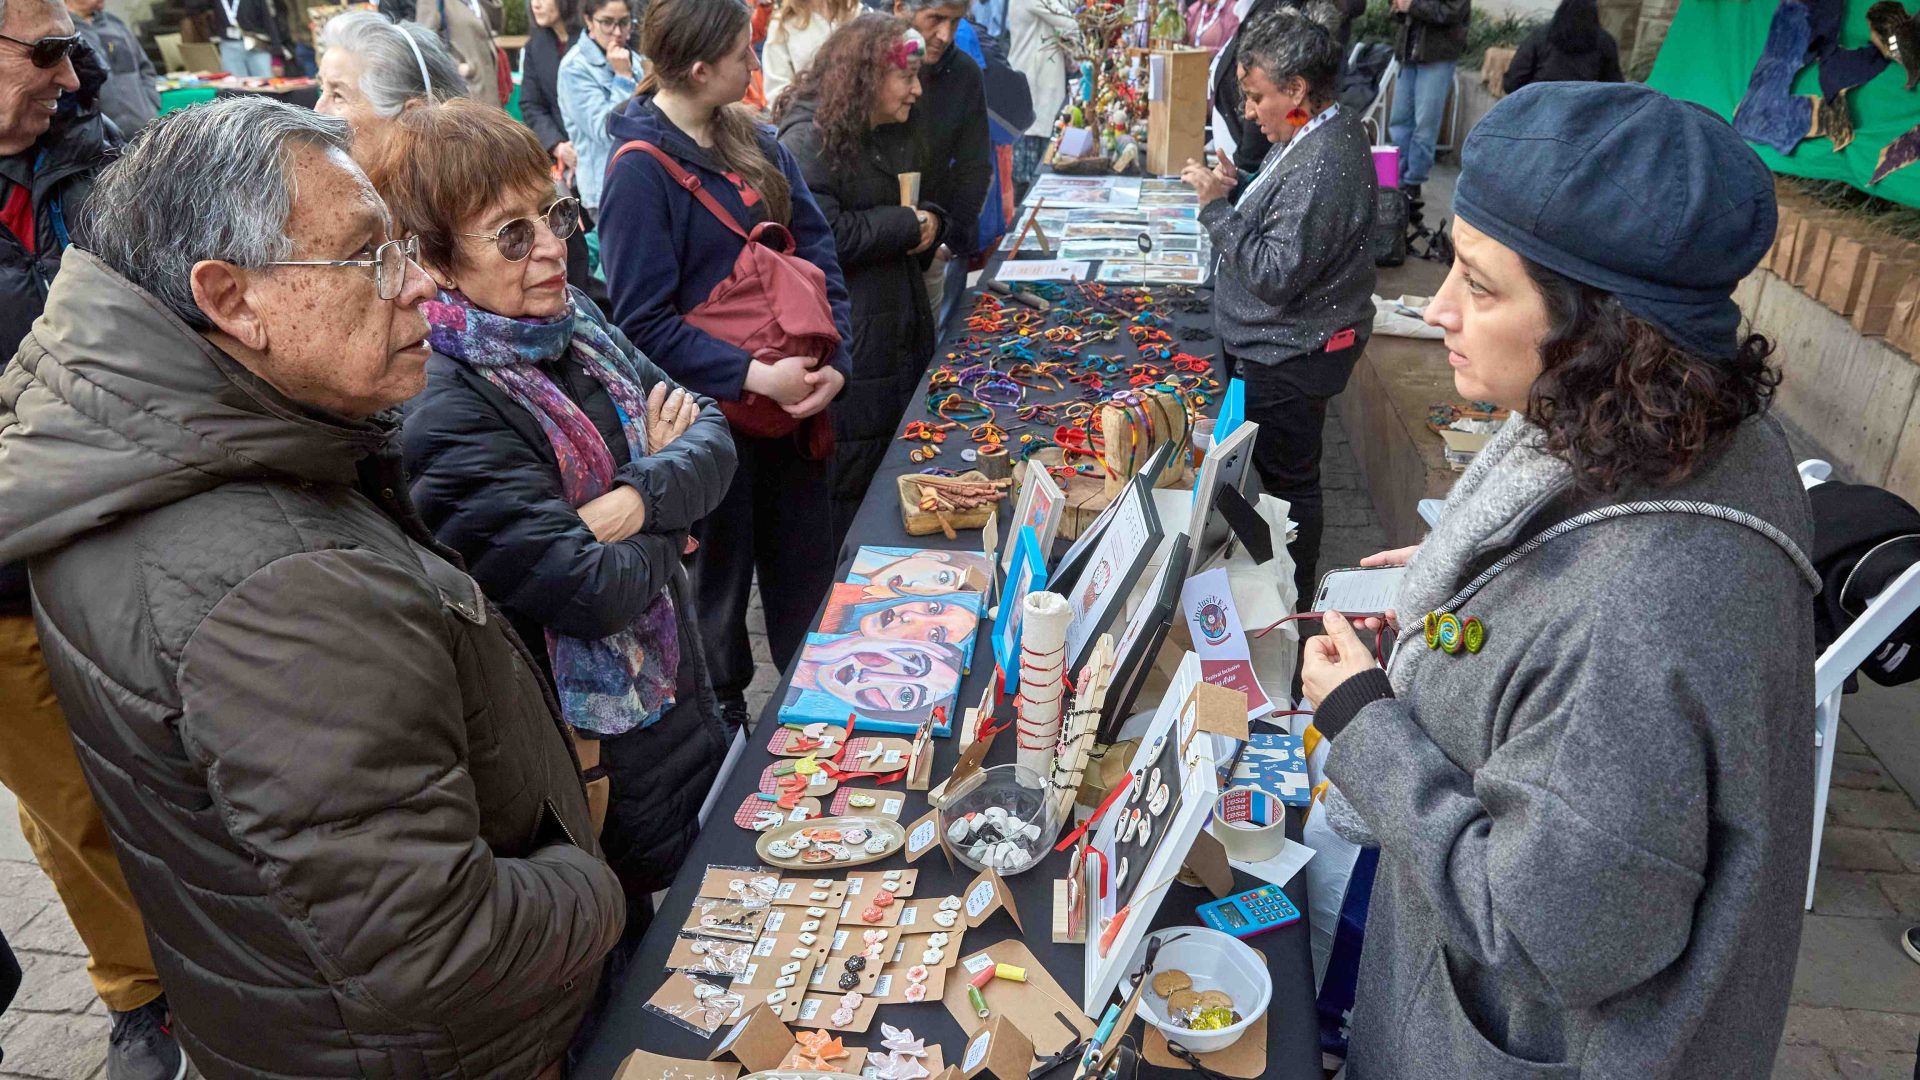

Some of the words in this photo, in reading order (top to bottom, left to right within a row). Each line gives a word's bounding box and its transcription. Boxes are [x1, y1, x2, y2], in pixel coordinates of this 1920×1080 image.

[1226, 798, 1246, 806] tesa
[1226, 804, 1246, 812] tesa
[1226, 811, 1247, 820] tesa
